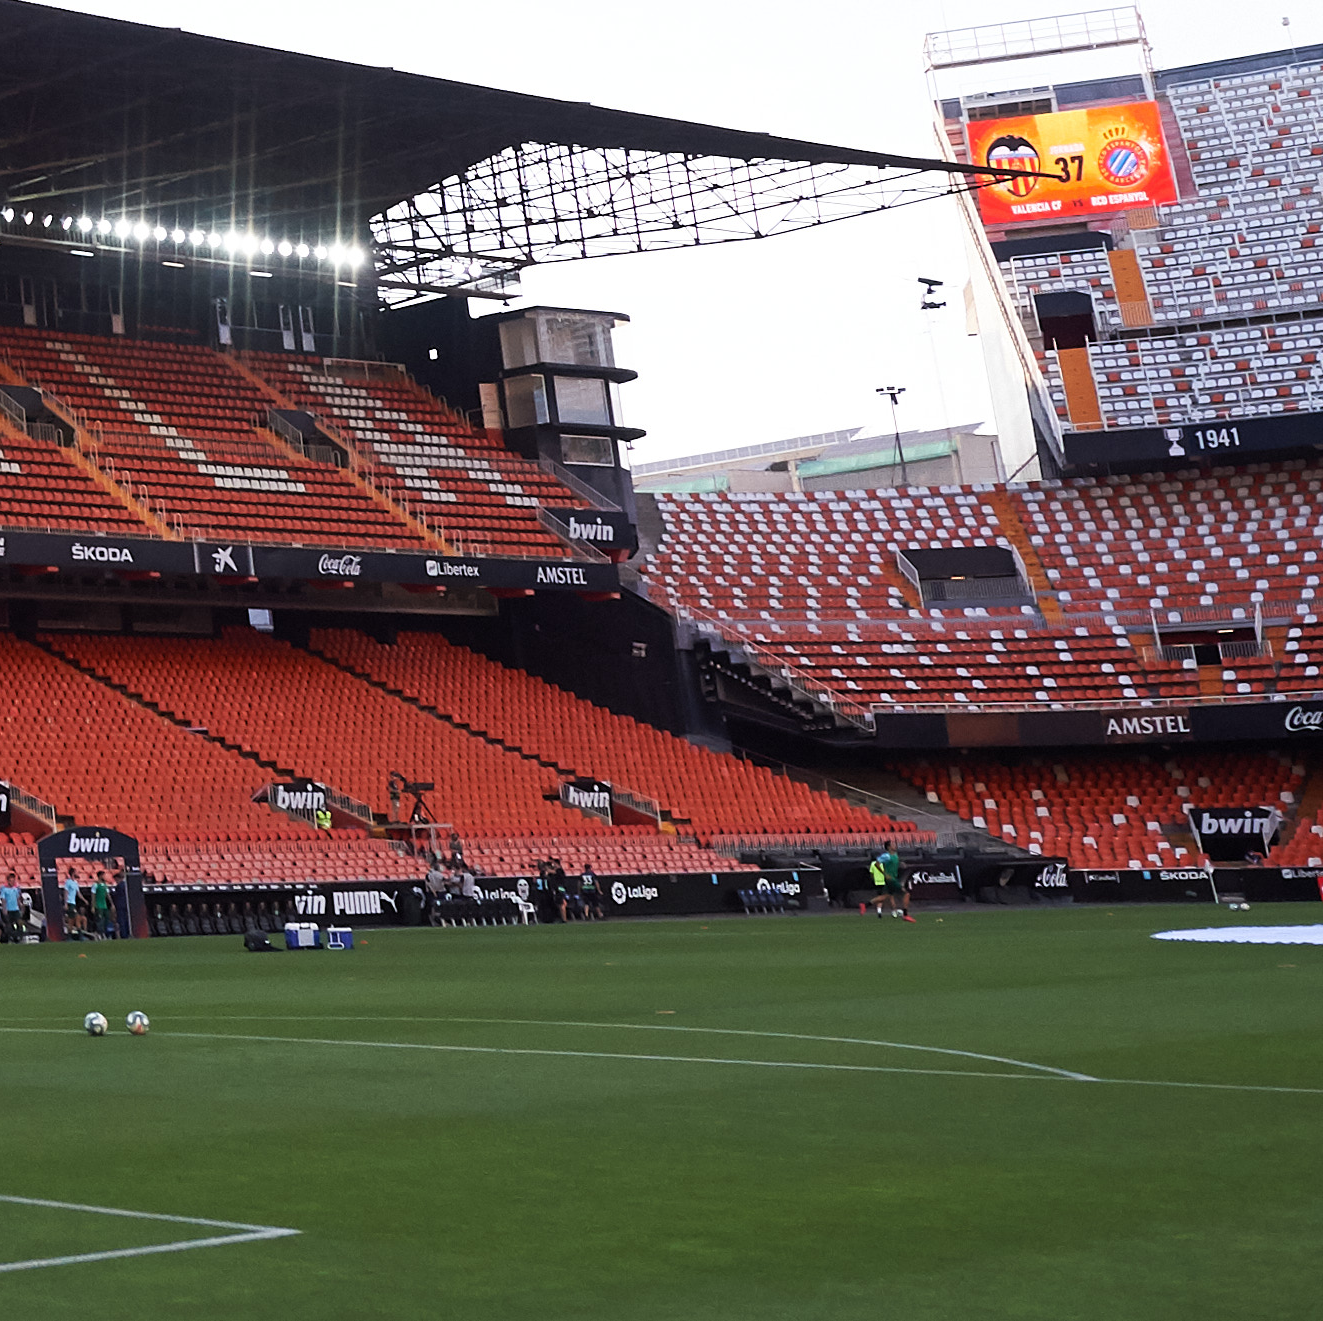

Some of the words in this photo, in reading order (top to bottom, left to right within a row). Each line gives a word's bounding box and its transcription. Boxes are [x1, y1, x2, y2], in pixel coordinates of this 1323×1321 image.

[1055, 155, 1084, 183] 37
[1011, 201, 1050, 215] VALENCIA
[1109, 191, 1150, 205] ESPANYOL
[1195, 426, 1241, 450] 1941
[568, 517, 615, 542] bwin
[71, 543, 134, 563] ŠKODA
[438, 561, 480, 578] Libertex
[536, 566, 588, 585] AMSTEL
[1106, 715, 1191, 735] AMSTEL
[277, 783, 326, 811] bwin
[68, 831, 111, 854] bwin
[295, 890, 326, 915] win
[333, 890, 382, 916] PUMA
[626, 883, 659, 901] LaLiga
